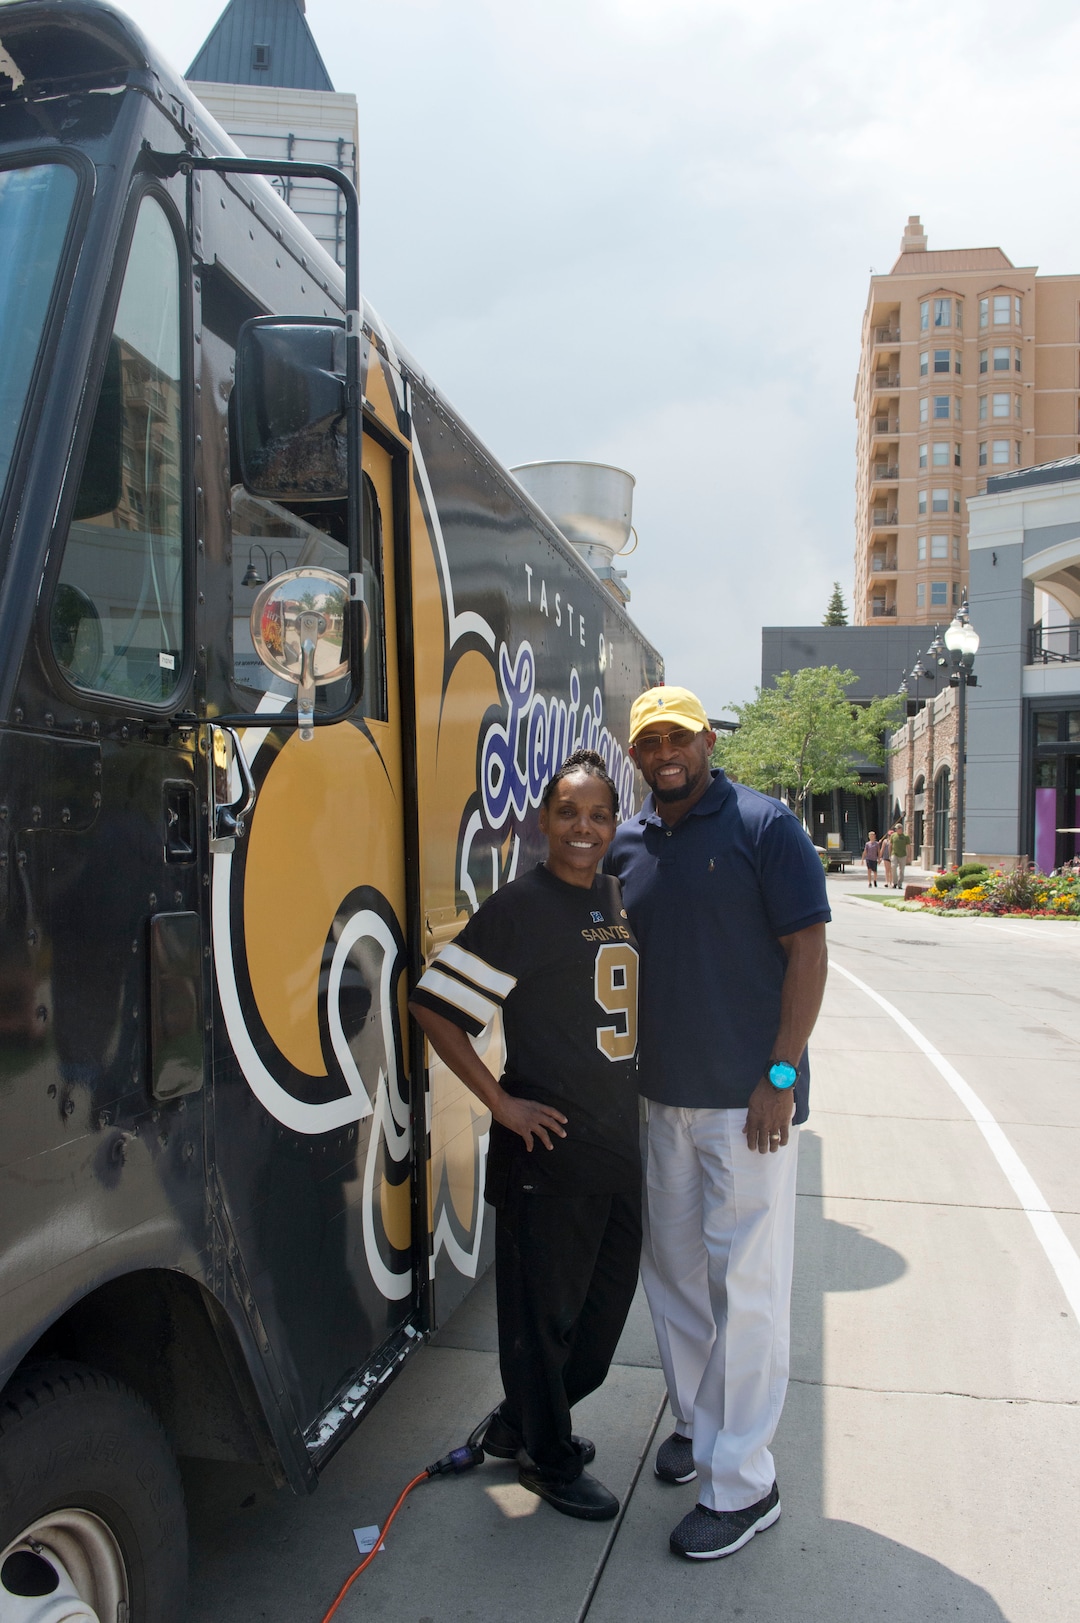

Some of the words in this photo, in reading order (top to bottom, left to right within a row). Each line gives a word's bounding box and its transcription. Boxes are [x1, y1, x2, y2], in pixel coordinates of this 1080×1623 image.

[524, 563, 586, 647] TASTE
[598, 632, 614, 671] OF
[581, 925, 630, 942] SAINTS
[594, 942, 640, 1063] 9
